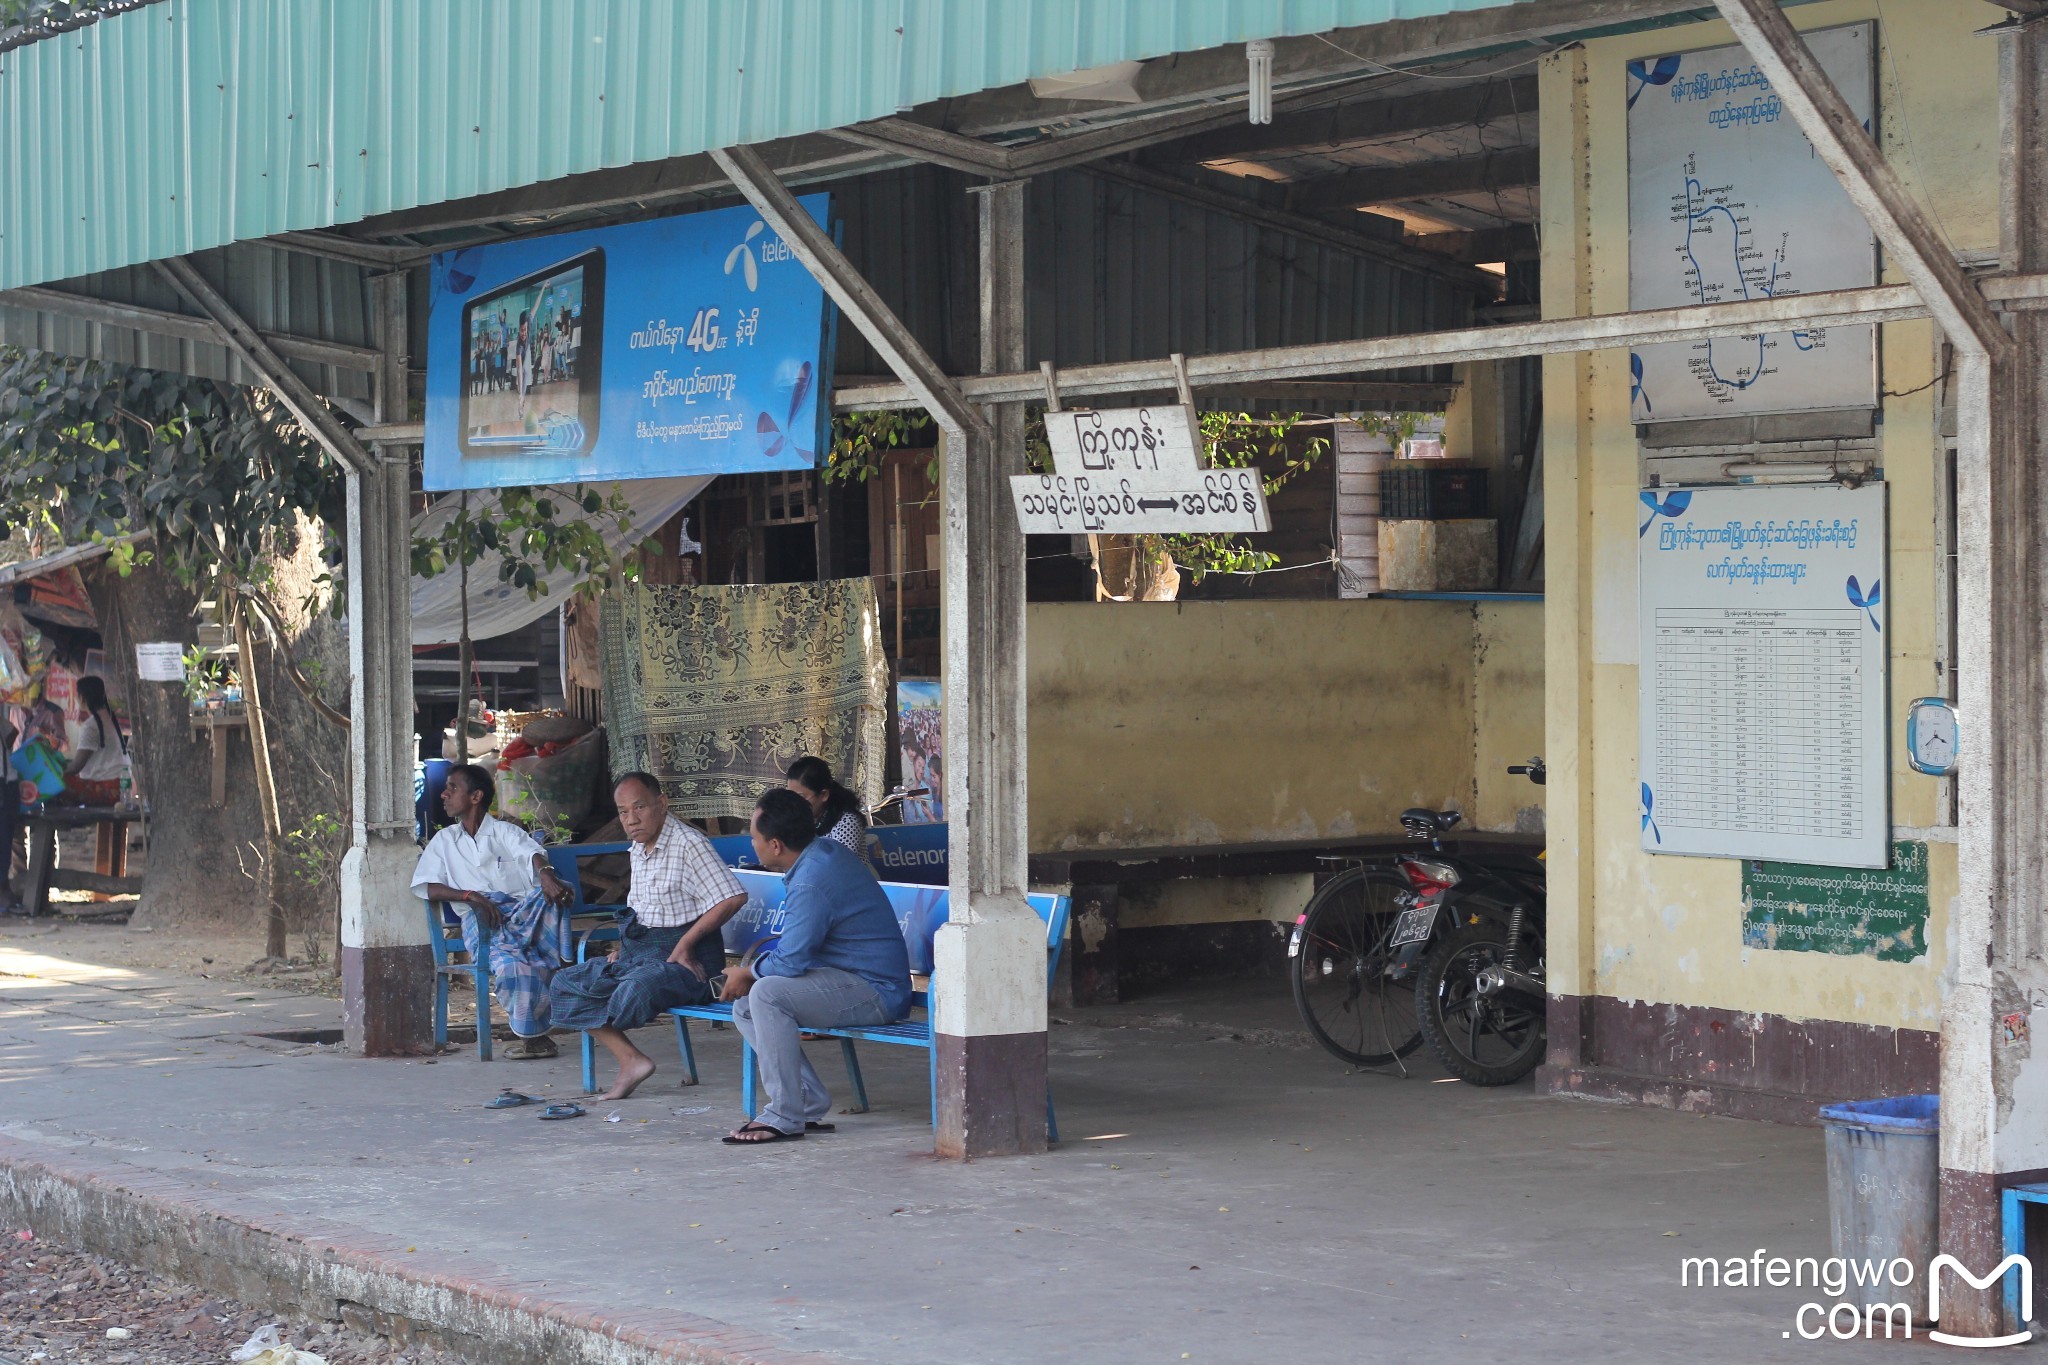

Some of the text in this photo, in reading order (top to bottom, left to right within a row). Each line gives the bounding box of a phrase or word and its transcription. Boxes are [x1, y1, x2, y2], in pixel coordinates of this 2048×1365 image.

[687, 309, 720, 352] 4G
[1074, 409, 1165, 470] ကြို့ကုန်း
[1022, 472, 1258, 531] သမိုင်းမြို့သစ် အင်းစိန်
[882, 846, 946, 867] telenor
